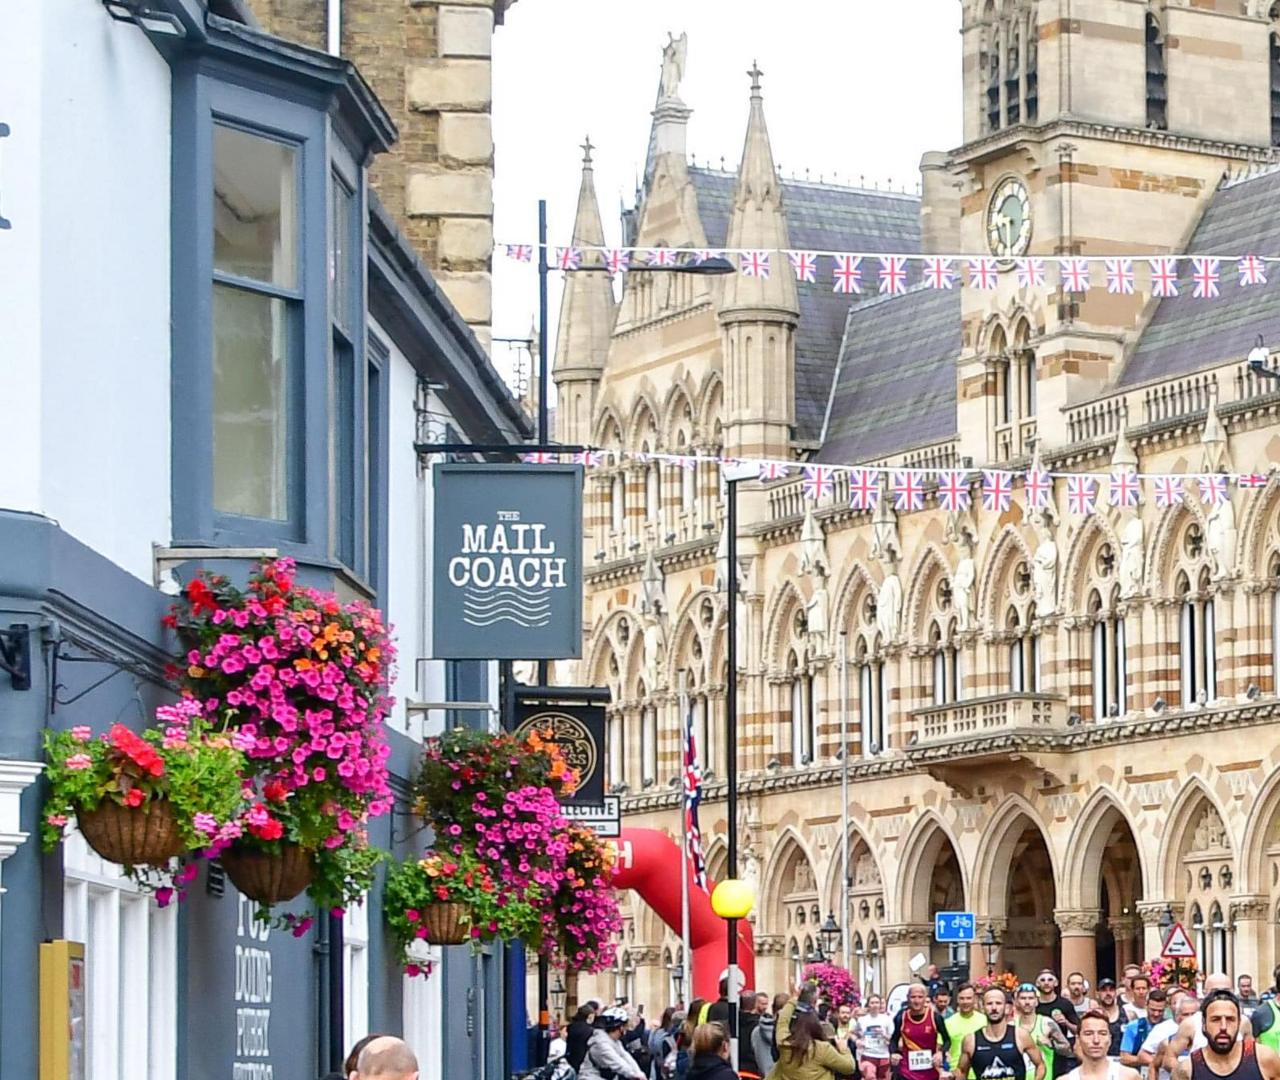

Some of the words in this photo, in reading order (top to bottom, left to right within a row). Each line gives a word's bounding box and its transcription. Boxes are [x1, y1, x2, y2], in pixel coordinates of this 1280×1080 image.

[497, 511, 520, 520] THE
[461, 523, 555, 554] MAIL
[448, 556, 567, 587] COACH
